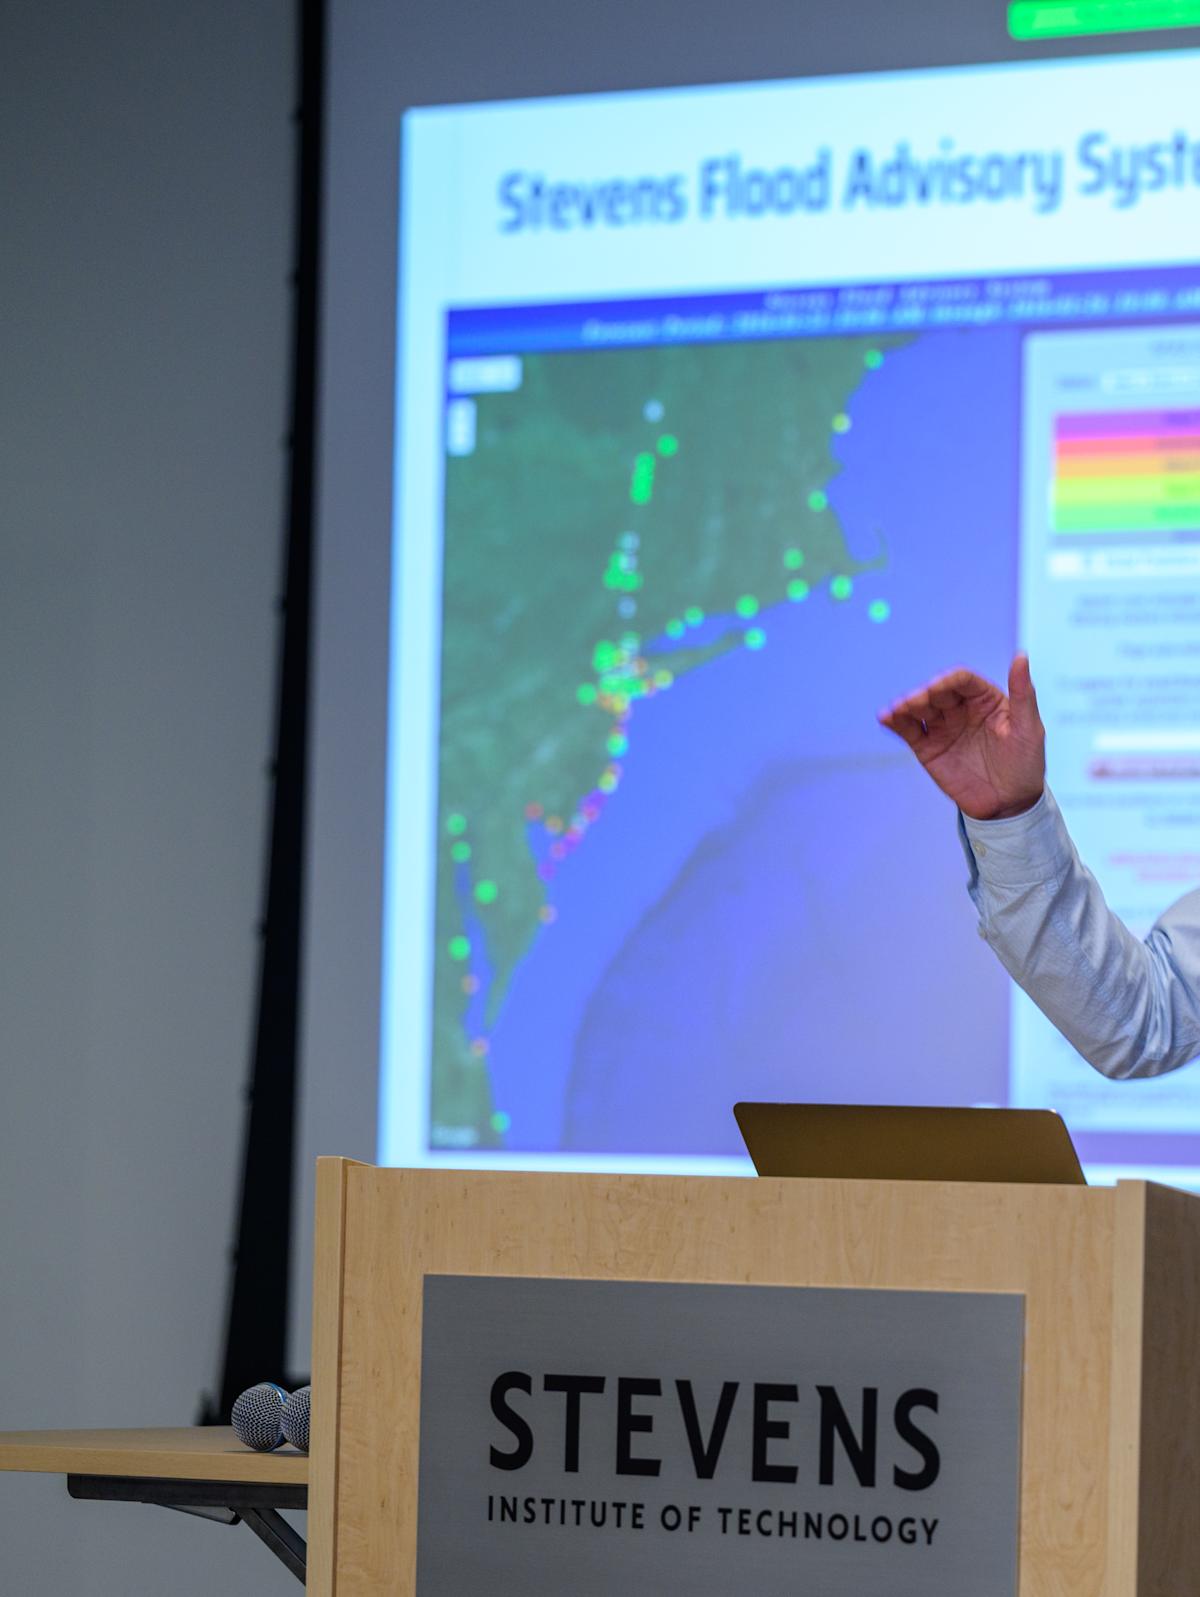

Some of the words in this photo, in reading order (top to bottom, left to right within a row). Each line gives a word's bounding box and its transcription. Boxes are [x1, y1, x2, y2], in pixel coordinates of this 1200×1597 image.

[497, 169, 686, 236] Stevens
[697, 145, 833, 220] Flood
[842, 136, 1064, 215] Advisory
[489, 1371, 941, 1491] STEVENS
[488, 1496, 644, 1529] INSTITUTE
[660, 1504, 702, 1533] OF
[718, 1507, 939, 1545] TECHNOLOGY
